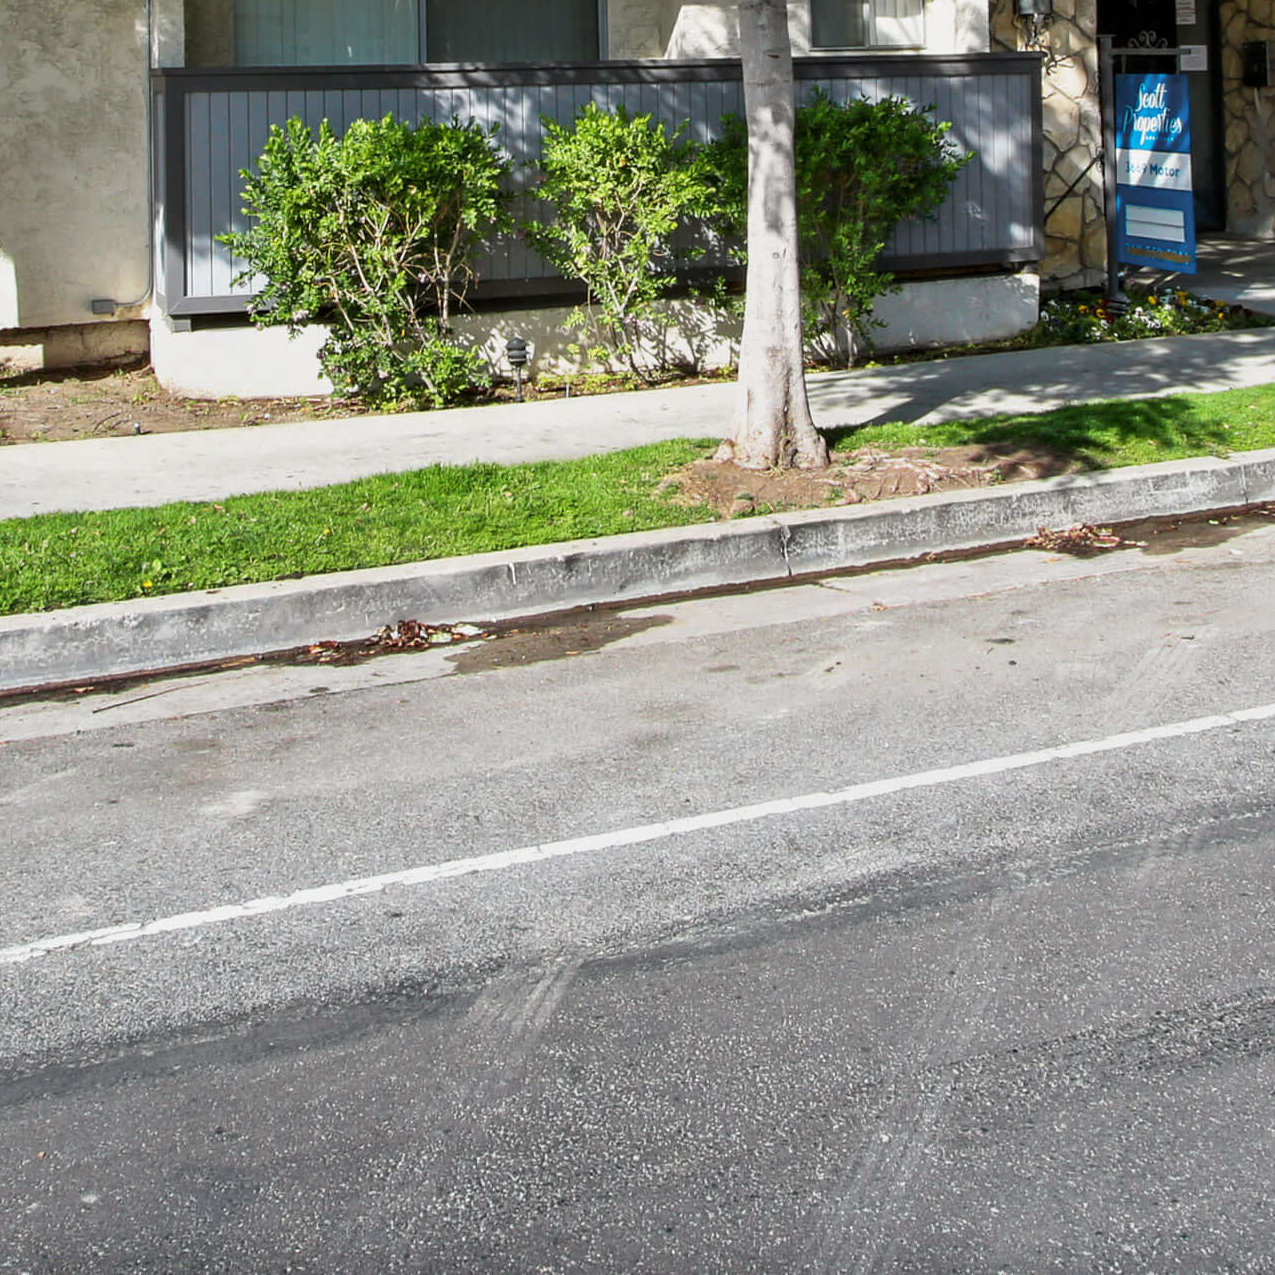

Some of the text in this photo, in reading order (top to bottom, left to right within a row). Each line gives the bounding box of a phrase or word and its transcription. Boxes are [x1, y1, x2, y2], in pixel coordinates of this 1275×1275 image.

[1135, 83, 1168, 112] Scott
[1123, 105, 1182, 145] Properties
[1150, 163, 1180, 178] Motor
